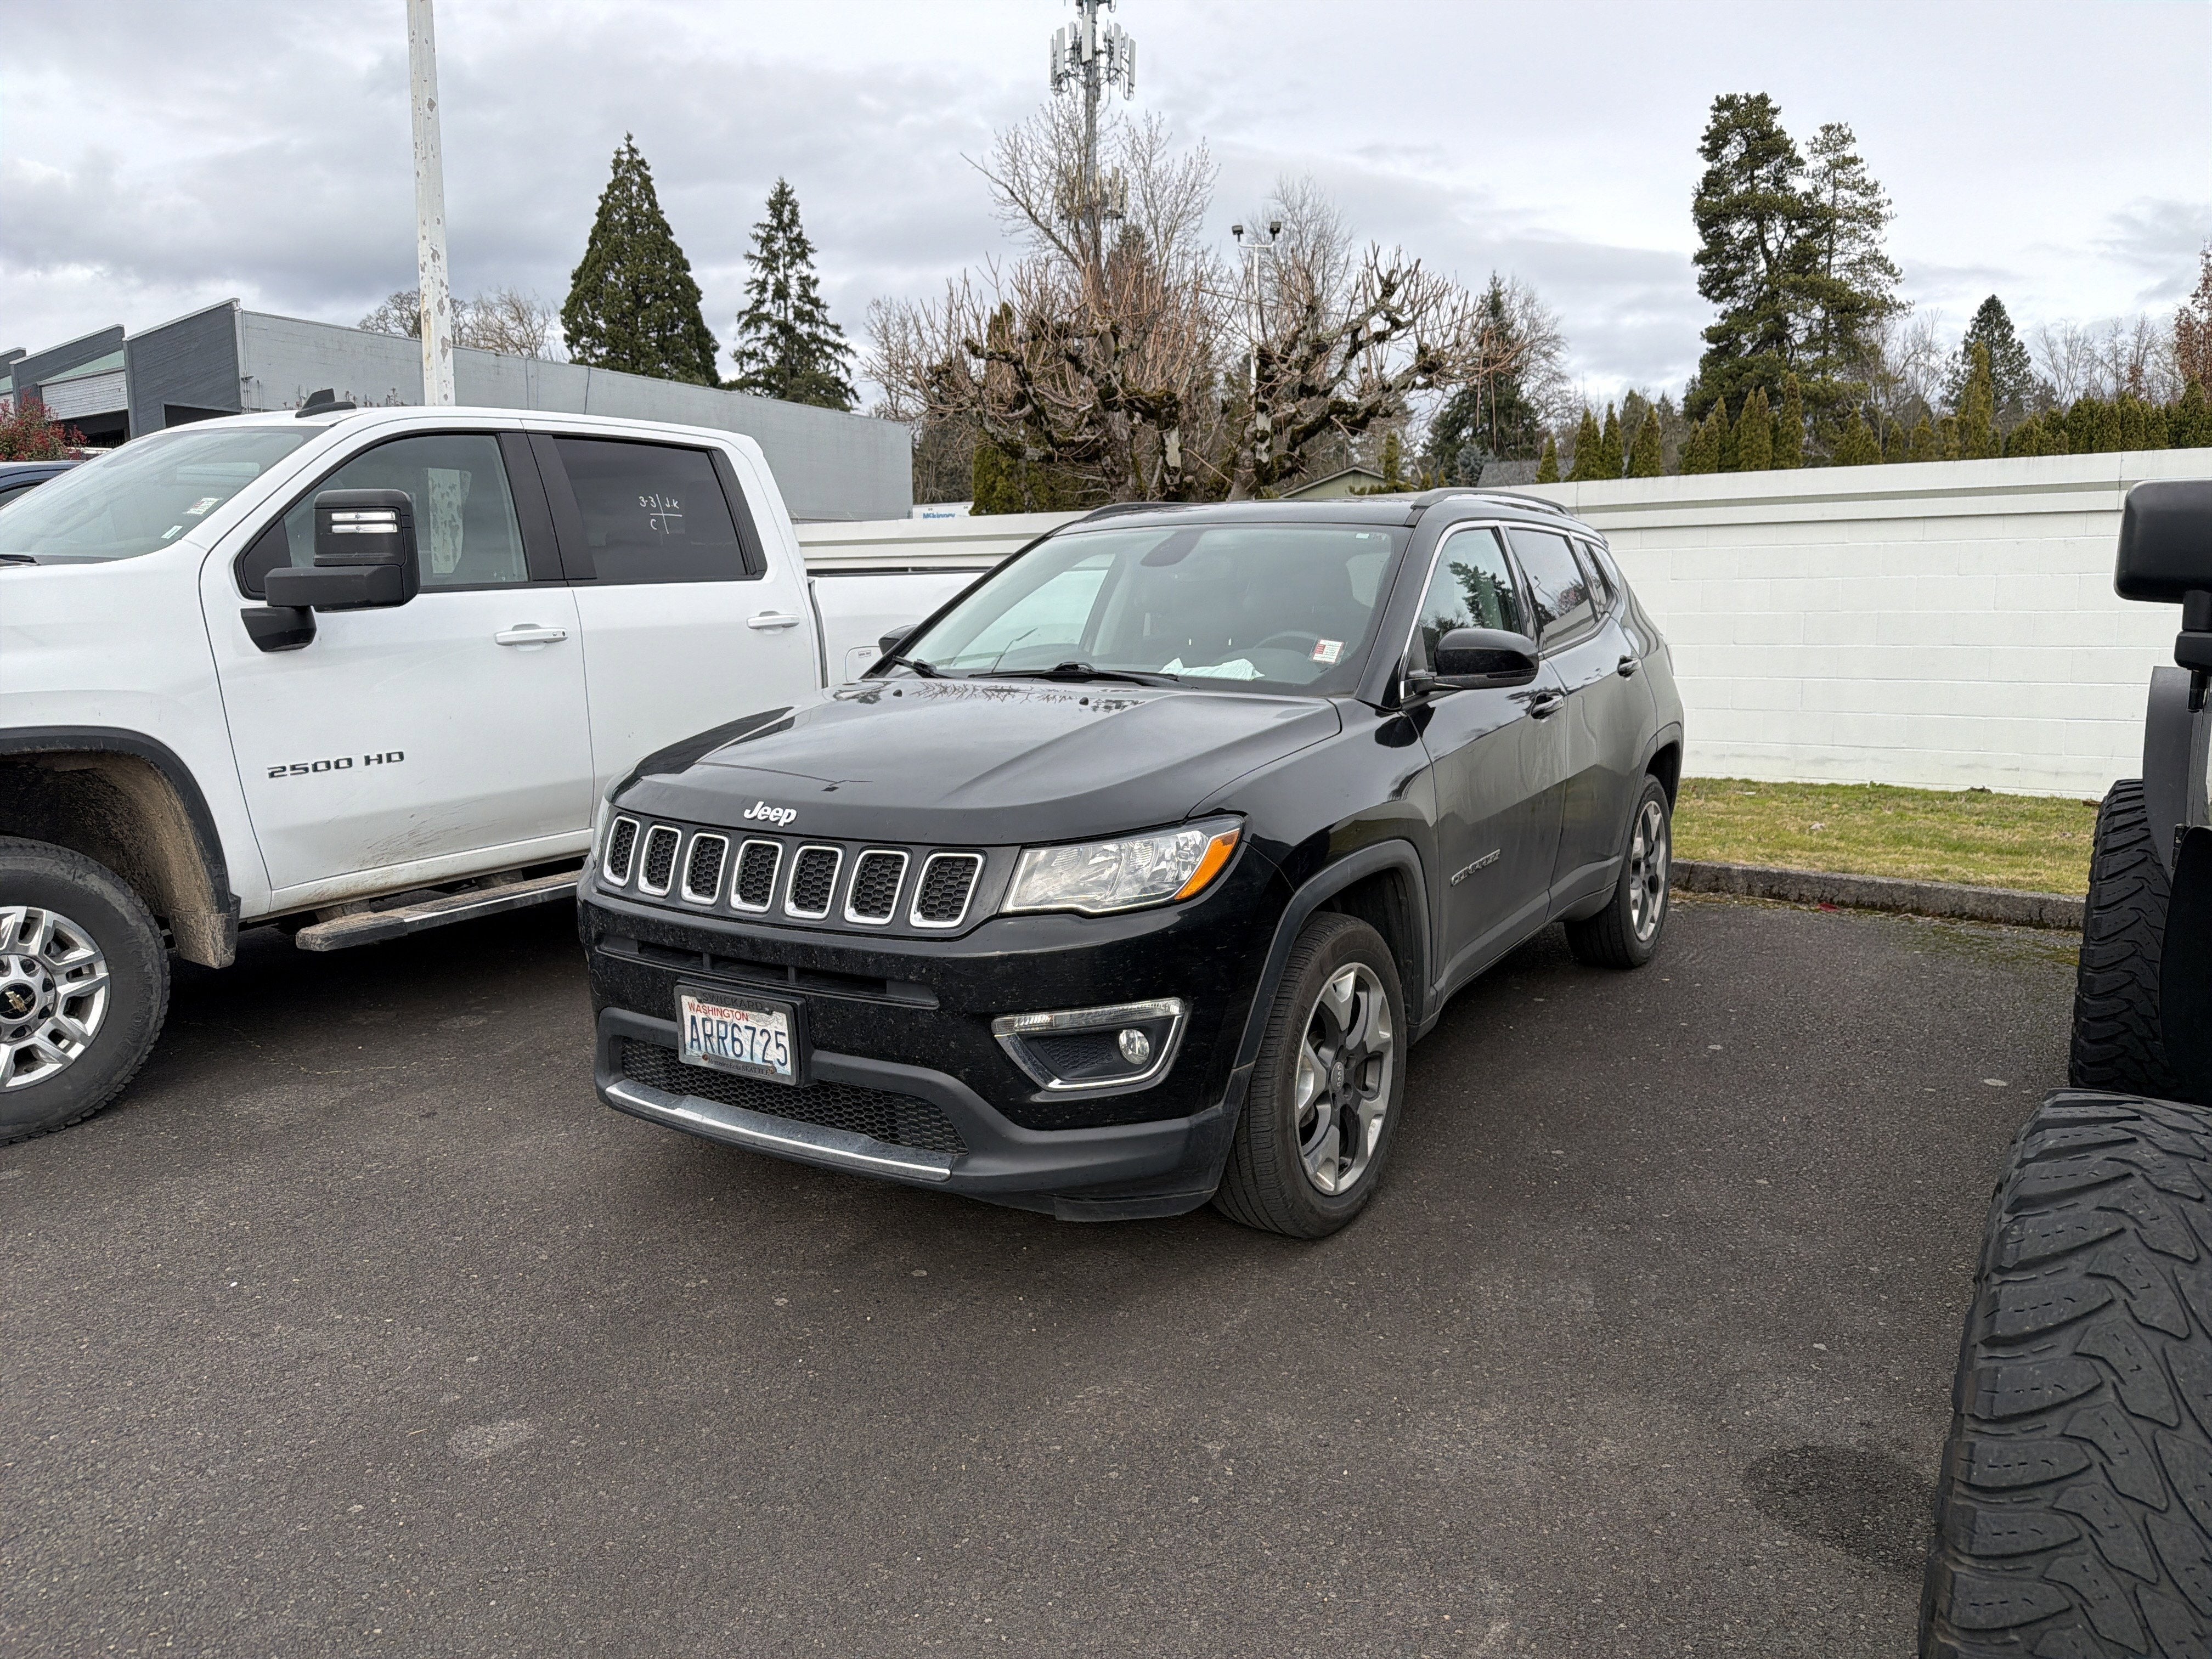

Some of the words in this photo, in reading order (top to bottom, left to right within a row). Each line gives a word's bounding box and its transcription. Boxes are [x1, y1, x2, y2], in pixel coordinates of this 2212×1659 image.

[267, 758, 353, 778] 2500
[364, 751, 404, 766] HD
[743, 801, 797, 828] Jeep
[687, 1001, 749, 1022] WASHINGTON
[702, 992, 763, 1011] SWICKARD
[690, 1015, 788, 1066] ARR6725
